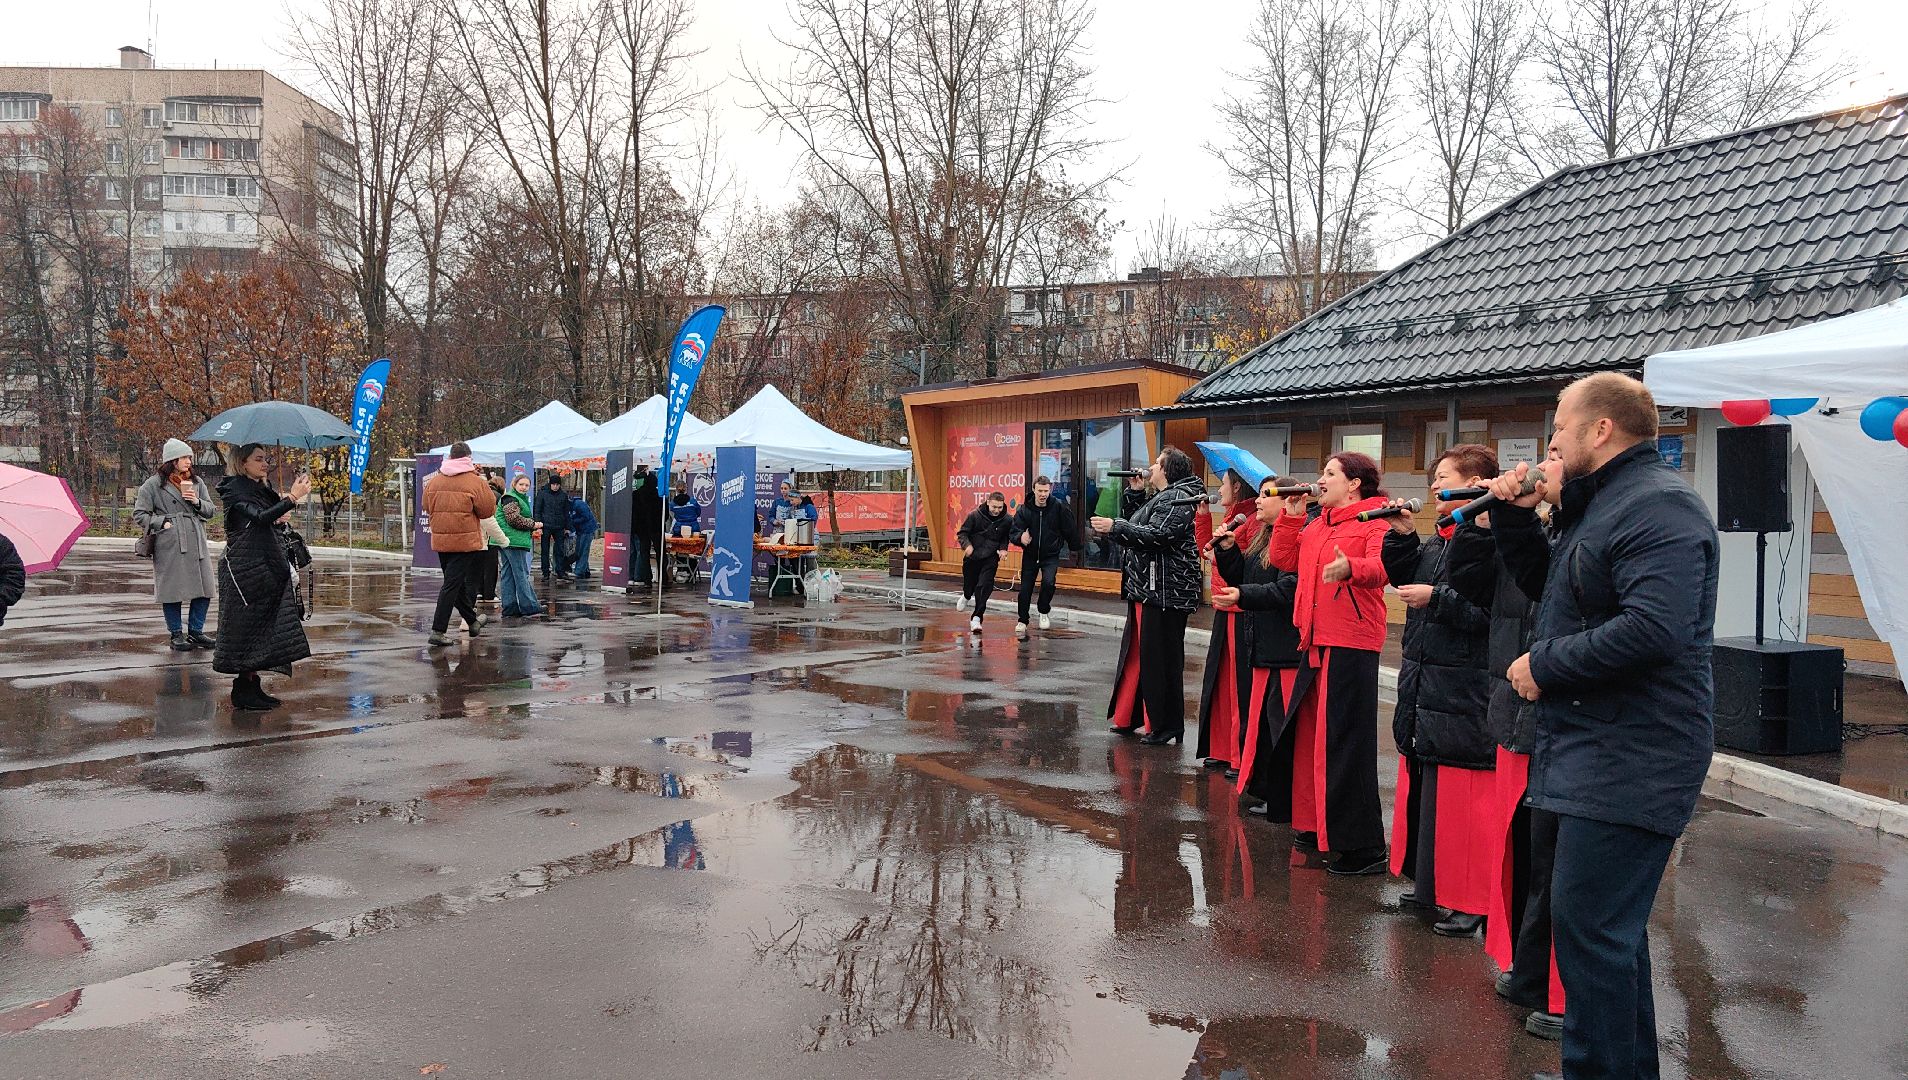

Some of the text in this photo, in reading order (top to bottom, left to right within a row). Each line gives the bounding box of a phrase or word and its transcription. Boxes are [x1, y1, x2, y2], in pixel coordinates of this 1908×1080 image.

[355, 413, 374, 477] РОССИЯ
[949, 474, 986, 488] ВОЗЬМИ
[988, 474, 995, 487] С
